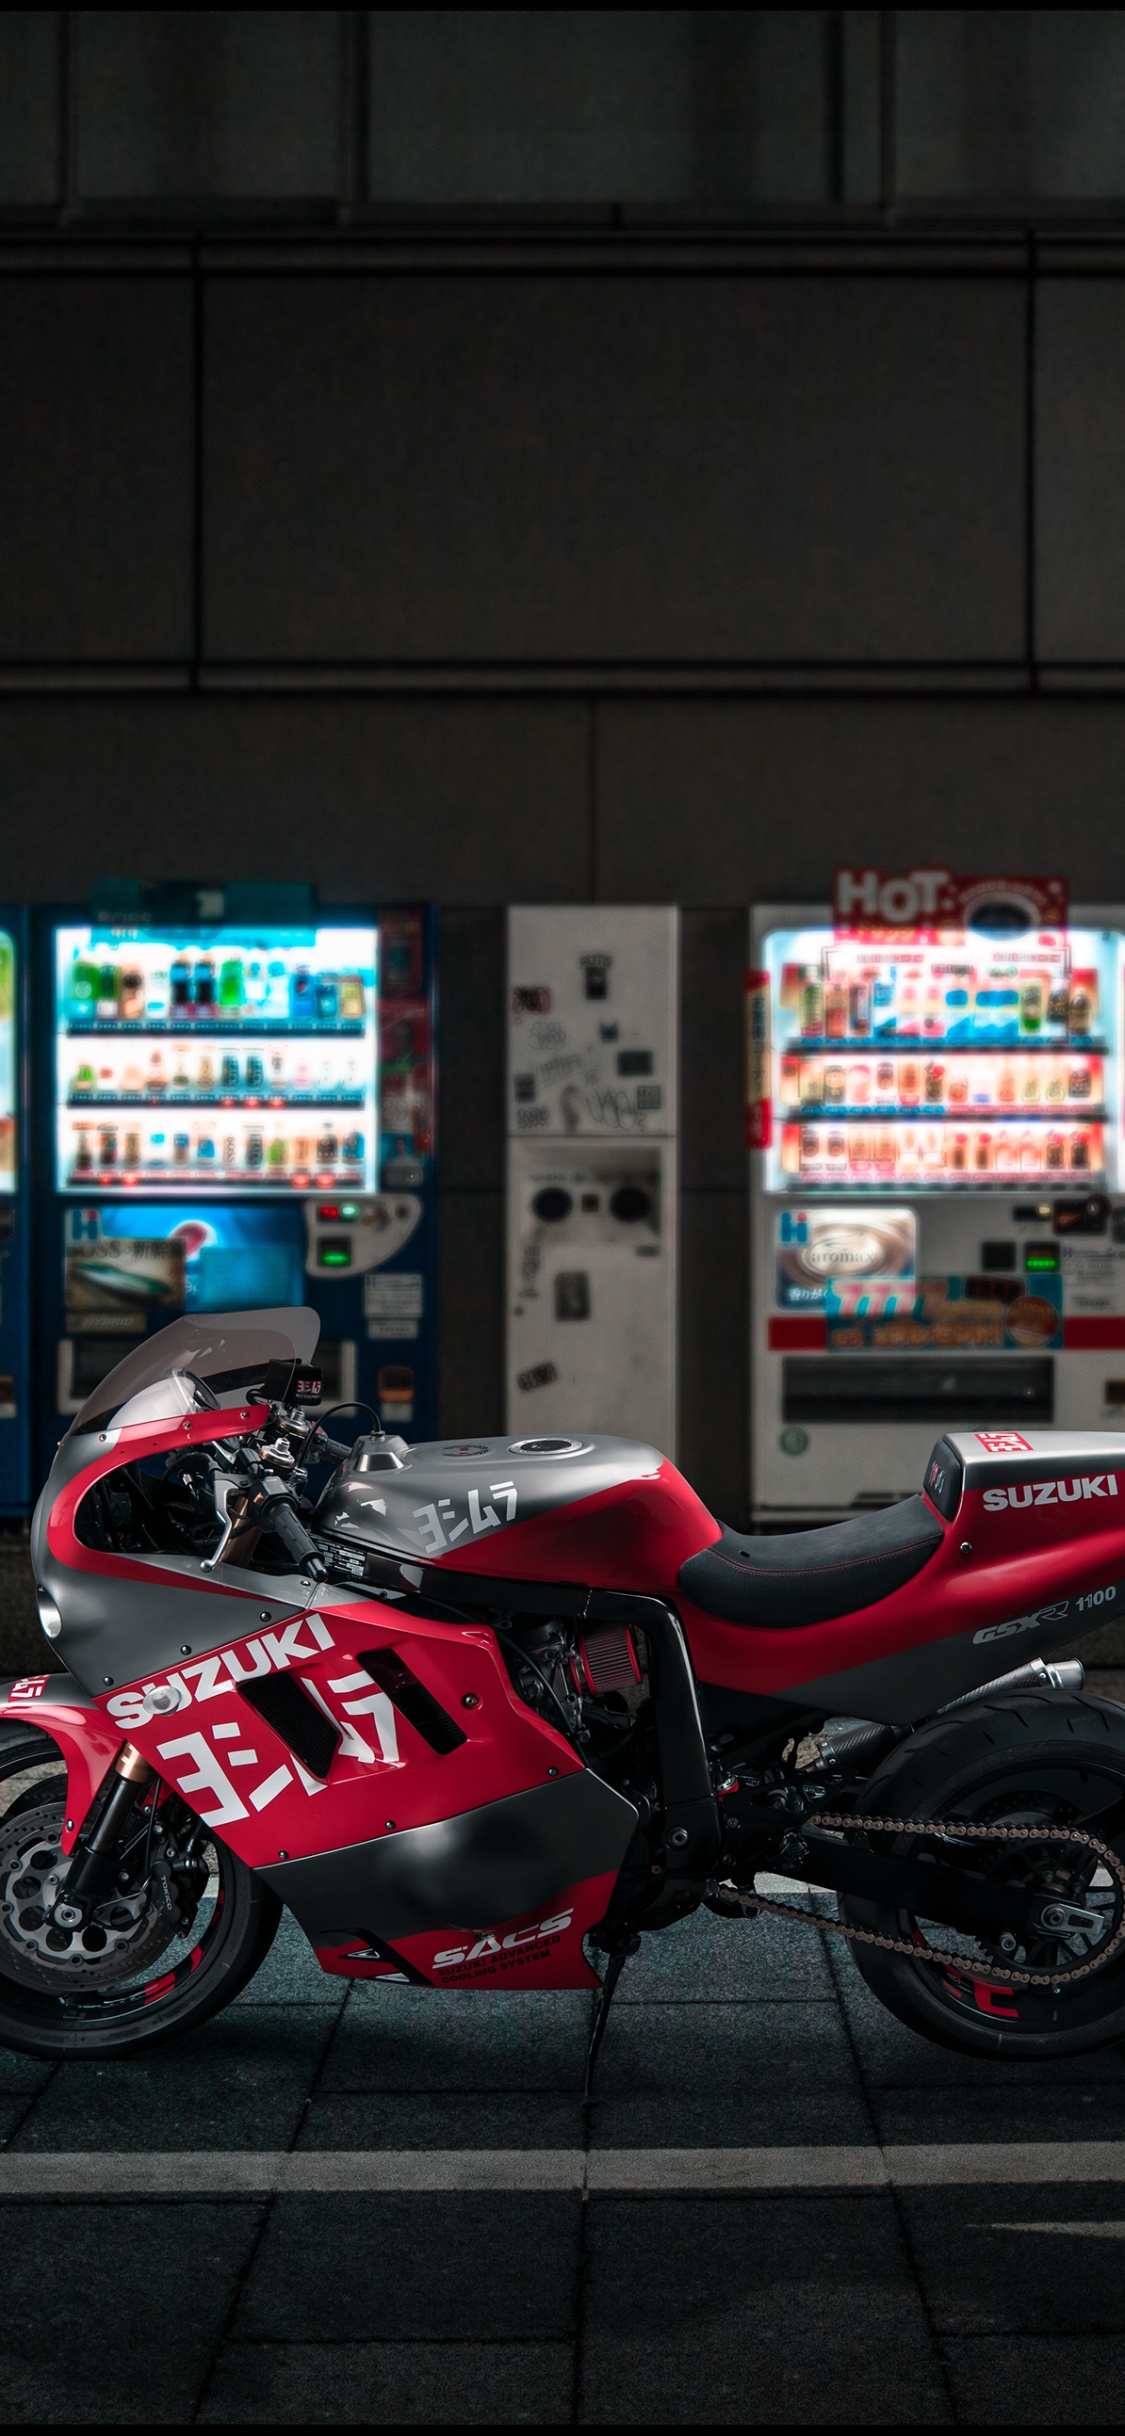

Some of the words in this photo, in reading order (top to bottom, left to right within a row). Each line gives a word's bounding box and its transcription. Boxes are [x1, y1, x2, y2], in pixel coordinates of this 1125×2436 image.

[836, 871, 949, 923] HOT
[811, 1250, 876, 1264] aromax
[81, 1316, 134, 1328] HYBRID
[982, 1474, 1119, 1512] SUZUKI
[411, 1480, 519, 1554] ヨシムラ
[1075, 1586, 1117, 1612] 1100
[106, 1613, 336, 1729] SUZUKI
[161, 1875, 173, 1911] TOKICO
[432, 1907, 574, 1969] SACS
[437, 1957, 487, 1977] SUZUKI
[490, 1934, 562, 1965] ADVANCED
[441, 1965, 497, 1984] COOLING
[500, 1949, 552, 1972] SYSTEM
